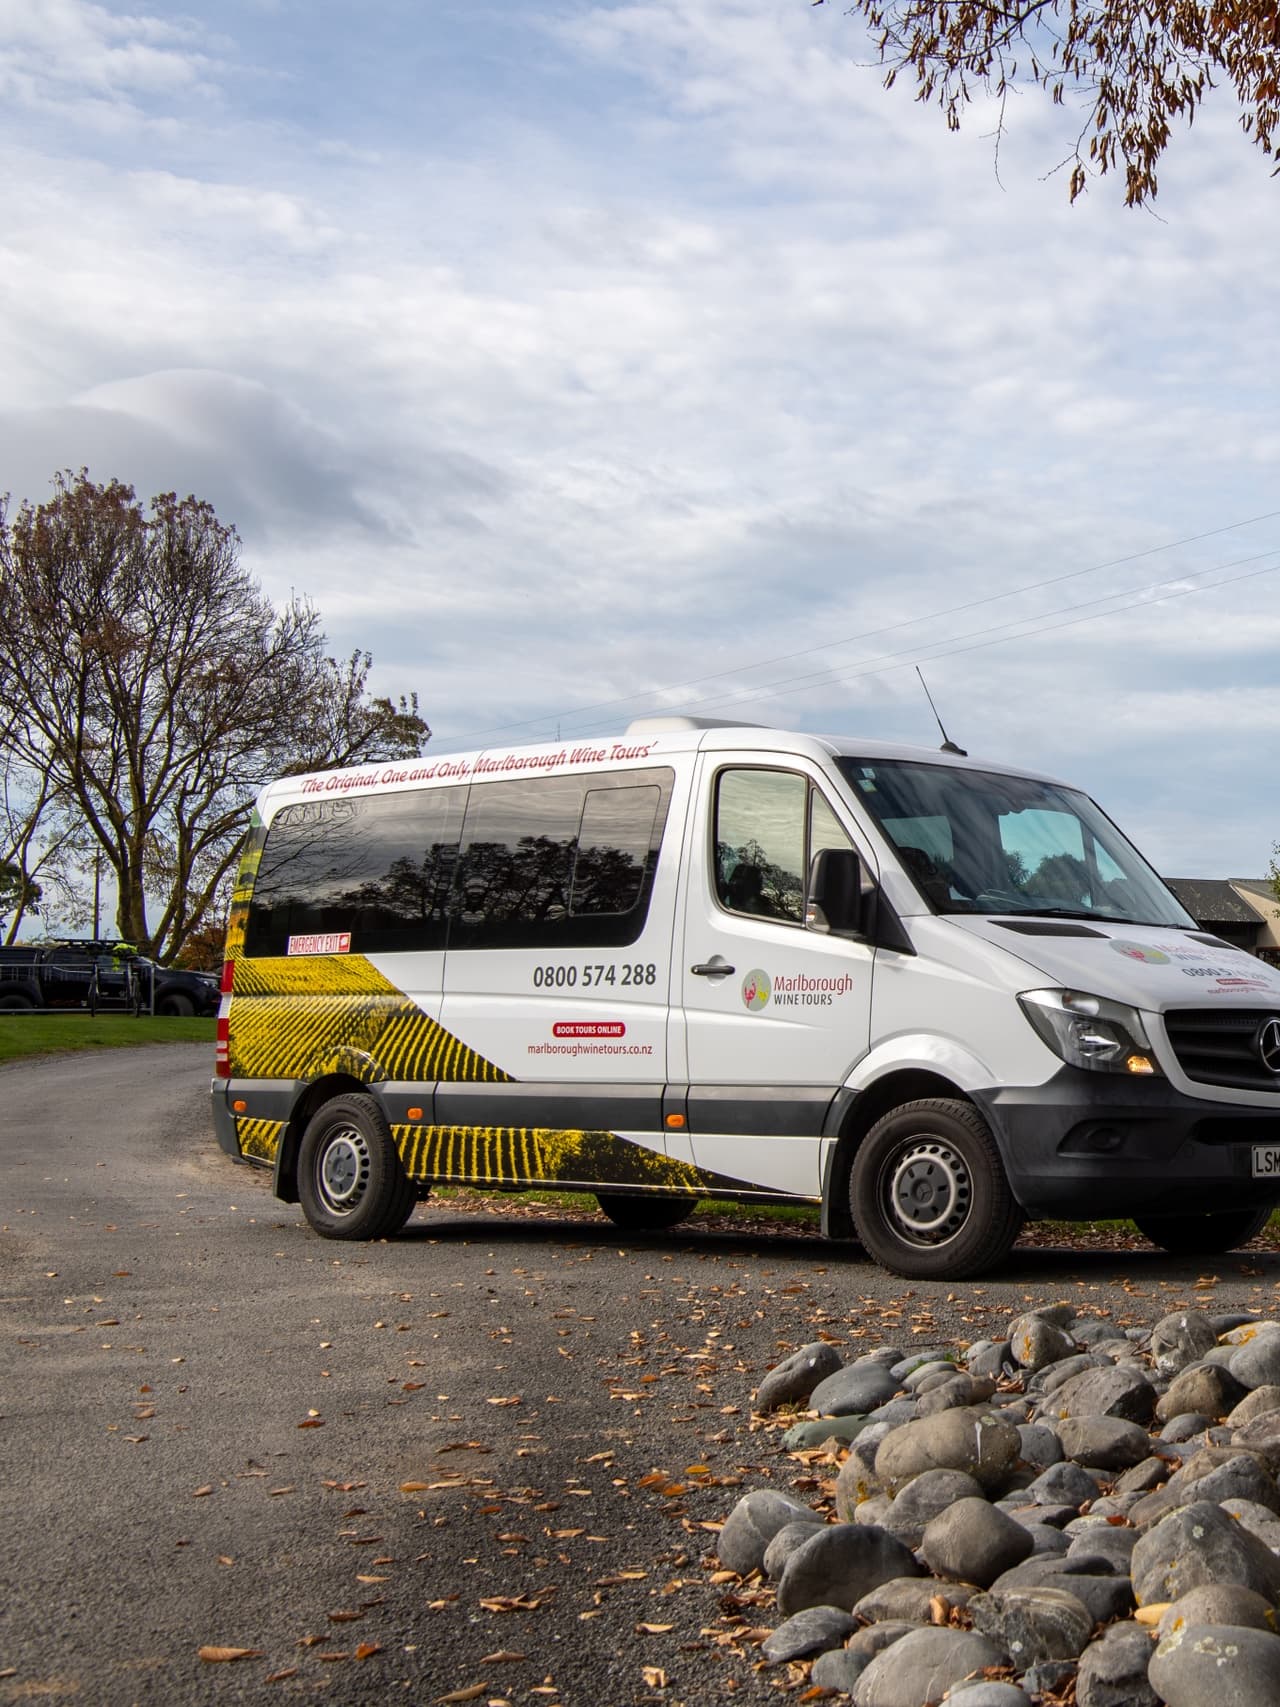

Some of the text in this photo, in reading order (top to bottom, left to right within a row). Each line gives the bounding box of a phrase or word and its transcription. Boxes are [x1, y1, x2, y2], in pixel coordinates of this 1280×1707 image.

[326, 771, 378, 793] Original,
[381, 769, 406, 784] One
[409, 763, 439, 781] and
[438, 760, 471, 781] Only,
[472, 749, 566, 774] Marlborough
[569, 747, 606, 765] Wine
[290, 935, 339, 954] EMERGENCY EXIT
[533, 963, 657, 988] 0800 574 288
[773, 973, 853, 995] Marlborough
[774, 993, 833, 1005] WINE TOURS
[556, 1025, 622, 1034] BOOK TOURS ONLINE
[527, 1042, 653, 1057] marlboroughwinetours.co.nz
